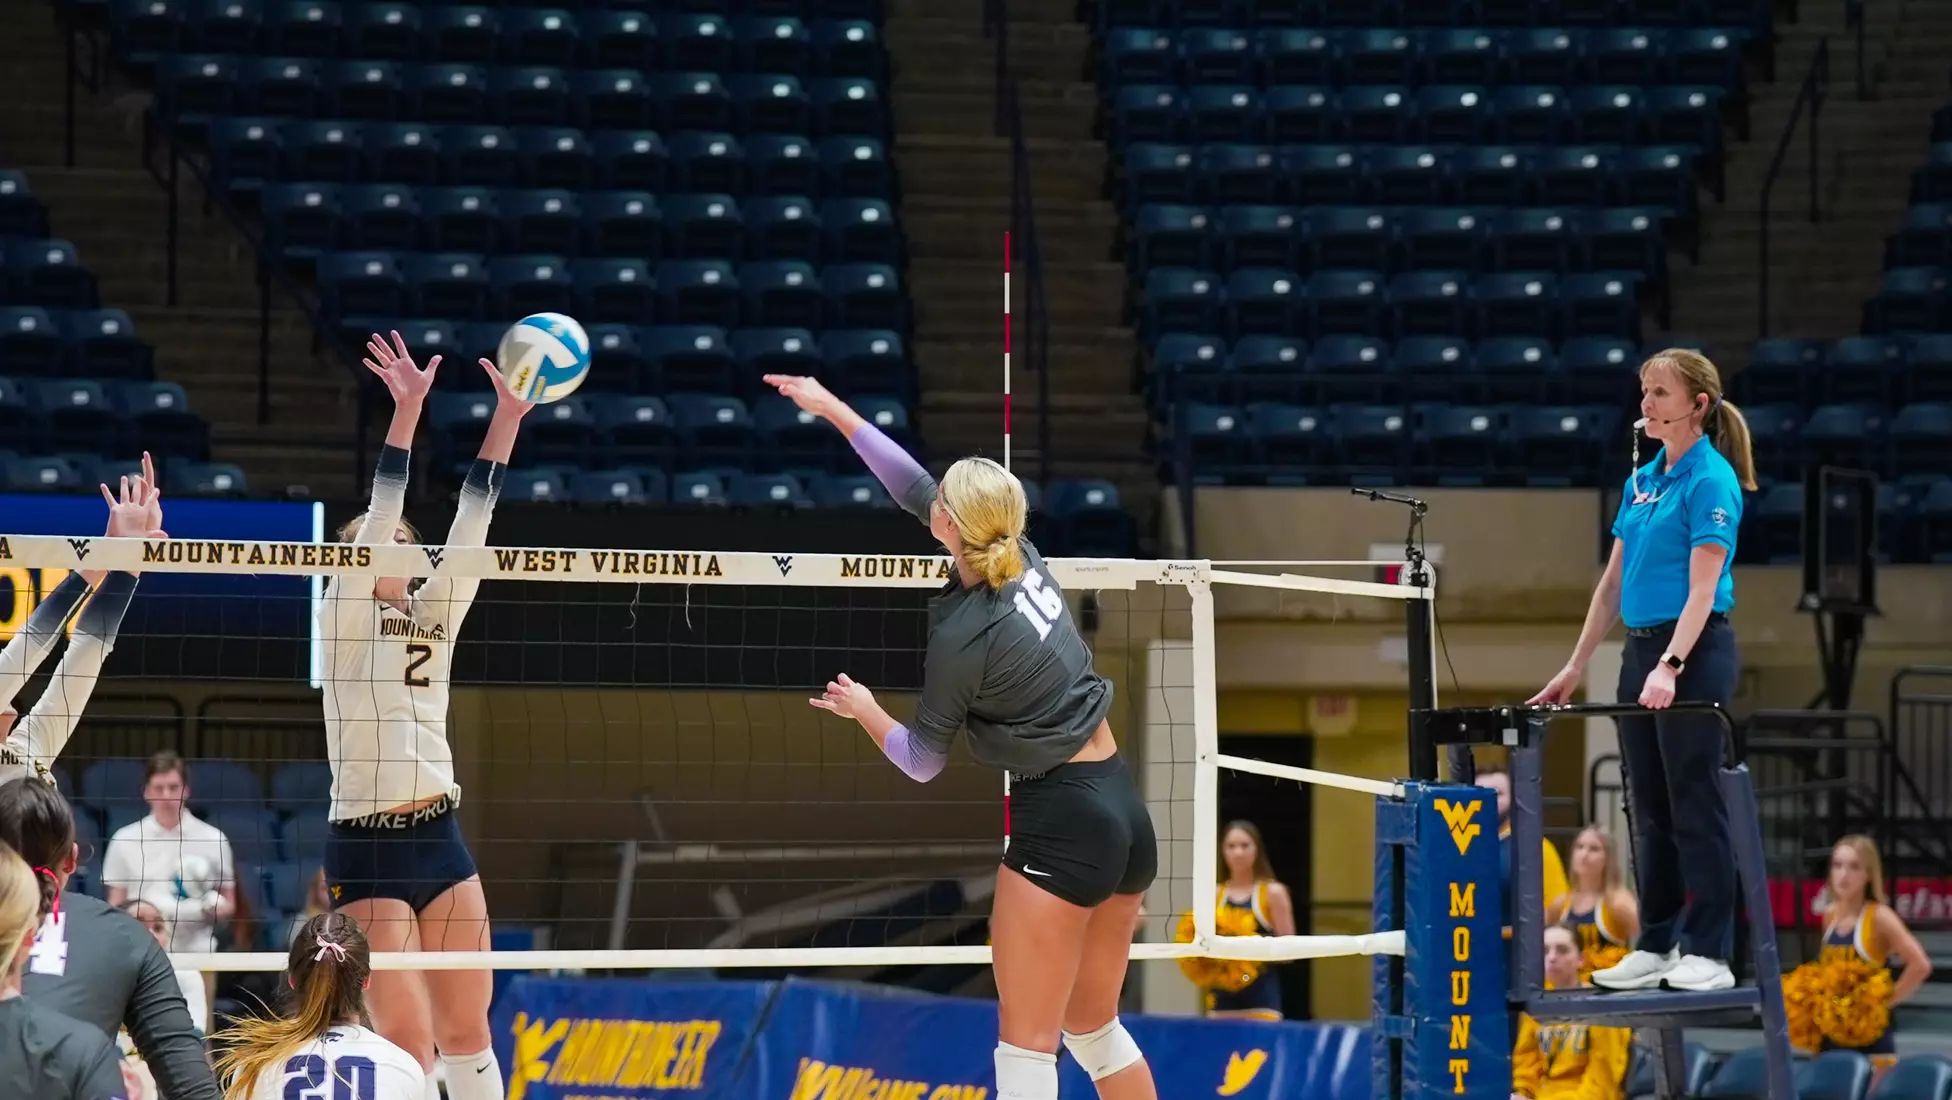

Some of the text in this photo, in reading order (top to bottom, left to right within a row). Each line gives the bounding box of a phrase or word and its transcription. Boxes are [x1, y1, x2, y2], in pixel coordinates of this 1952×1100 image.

[142, 541, 371, 568] MOUNTAINEERS
[495, 550, 577, 572] WEST
[591, 552, 722, 577] VIRGINIA
[840, 557, 950, 578] MOUNTA
[1013, 567, 1062, 642] 16
[405, 643, 432, 687] 2
[350, 812, 407, 829] NIKE
[1448, 882, 1475, 1094] MOUNT
[283, 1053, 376, 1100] 20
